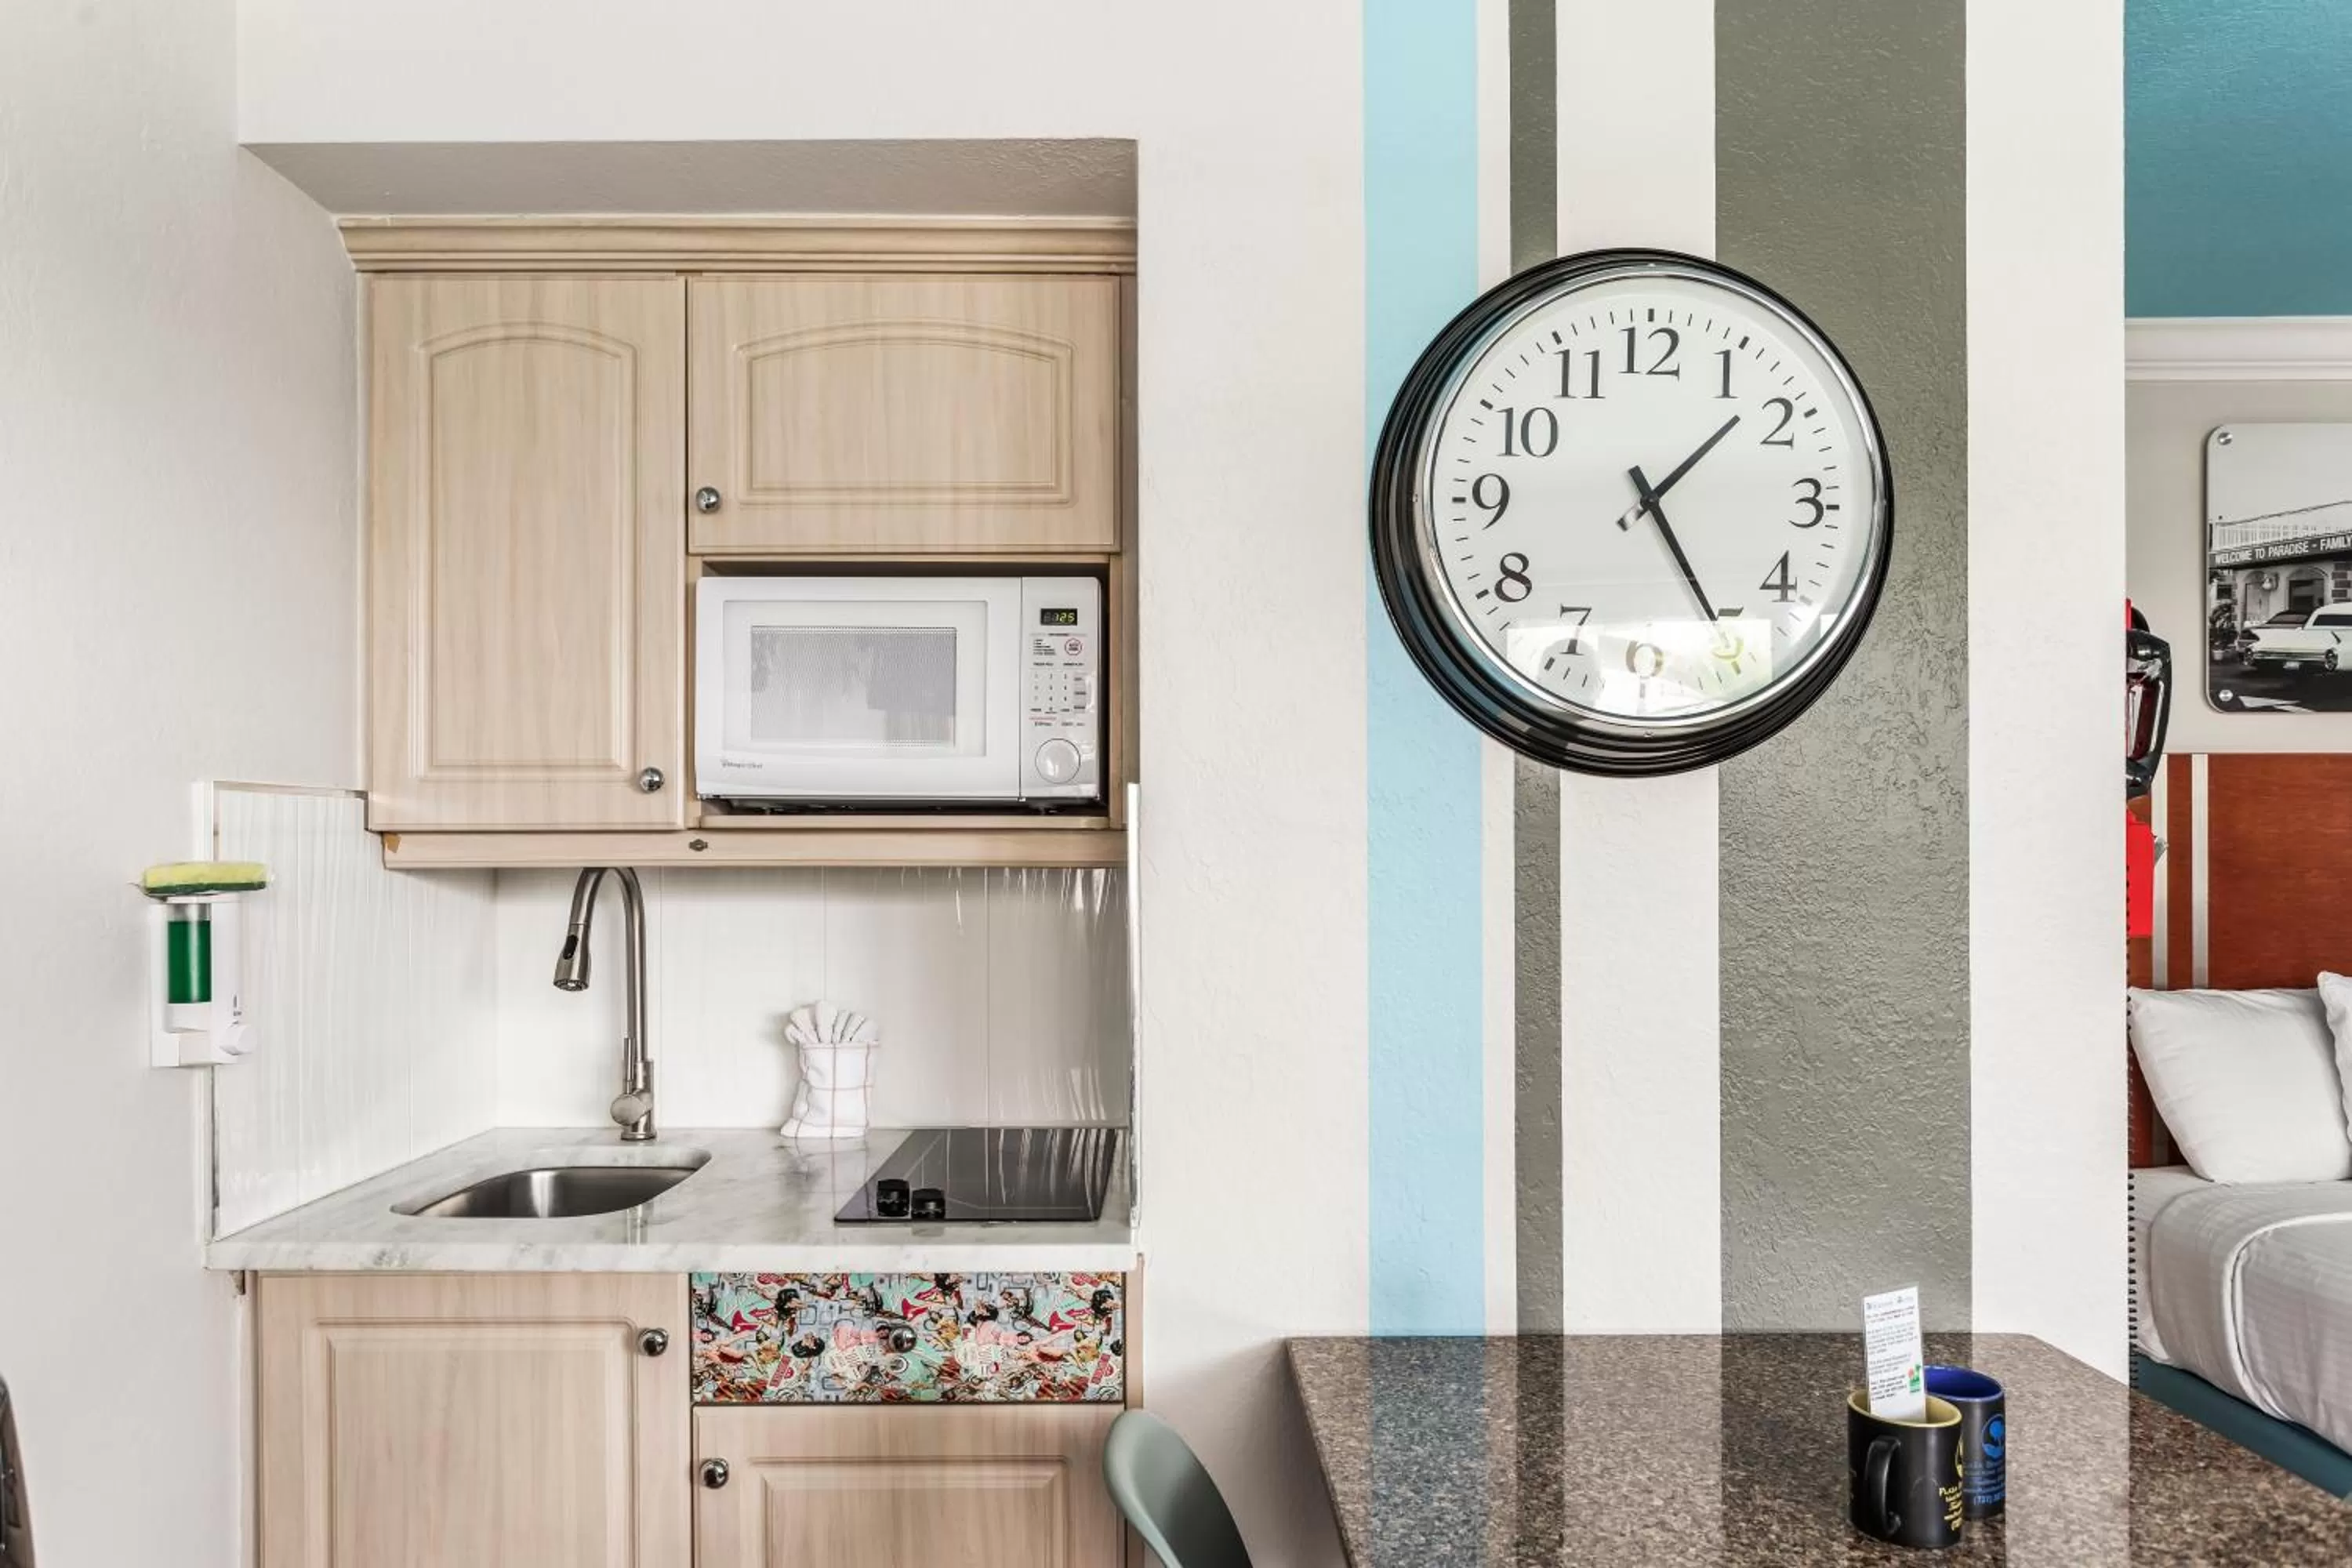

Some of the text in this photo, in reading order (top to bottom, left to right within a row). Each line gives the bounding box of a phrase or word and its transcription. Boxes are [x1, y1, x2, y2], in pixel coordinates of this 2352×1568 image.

[1555, 349, 1606, 399] 11
[1619, 327, 1680, 381] 12
[1713, 349, 1738, 399] 1
[1497, 407, 1559, 457] 10
[1760, 397, 1795, 448] 2
[1472, 474, 1510, 530] 9
[1788, 477, 1824, 528] 3
[2216, 551, 2252, 564] WELCOME
[2255, 548, 2265, 559] TO
[2268, 541, 2309, 557] PARADISE
[2320, 534, 2352, 551] FAMILY
[1494, 552, 1532, 603] 8
[1759, 550, 1798, 602] 4
[1559, 604, 1592, 656] 7
